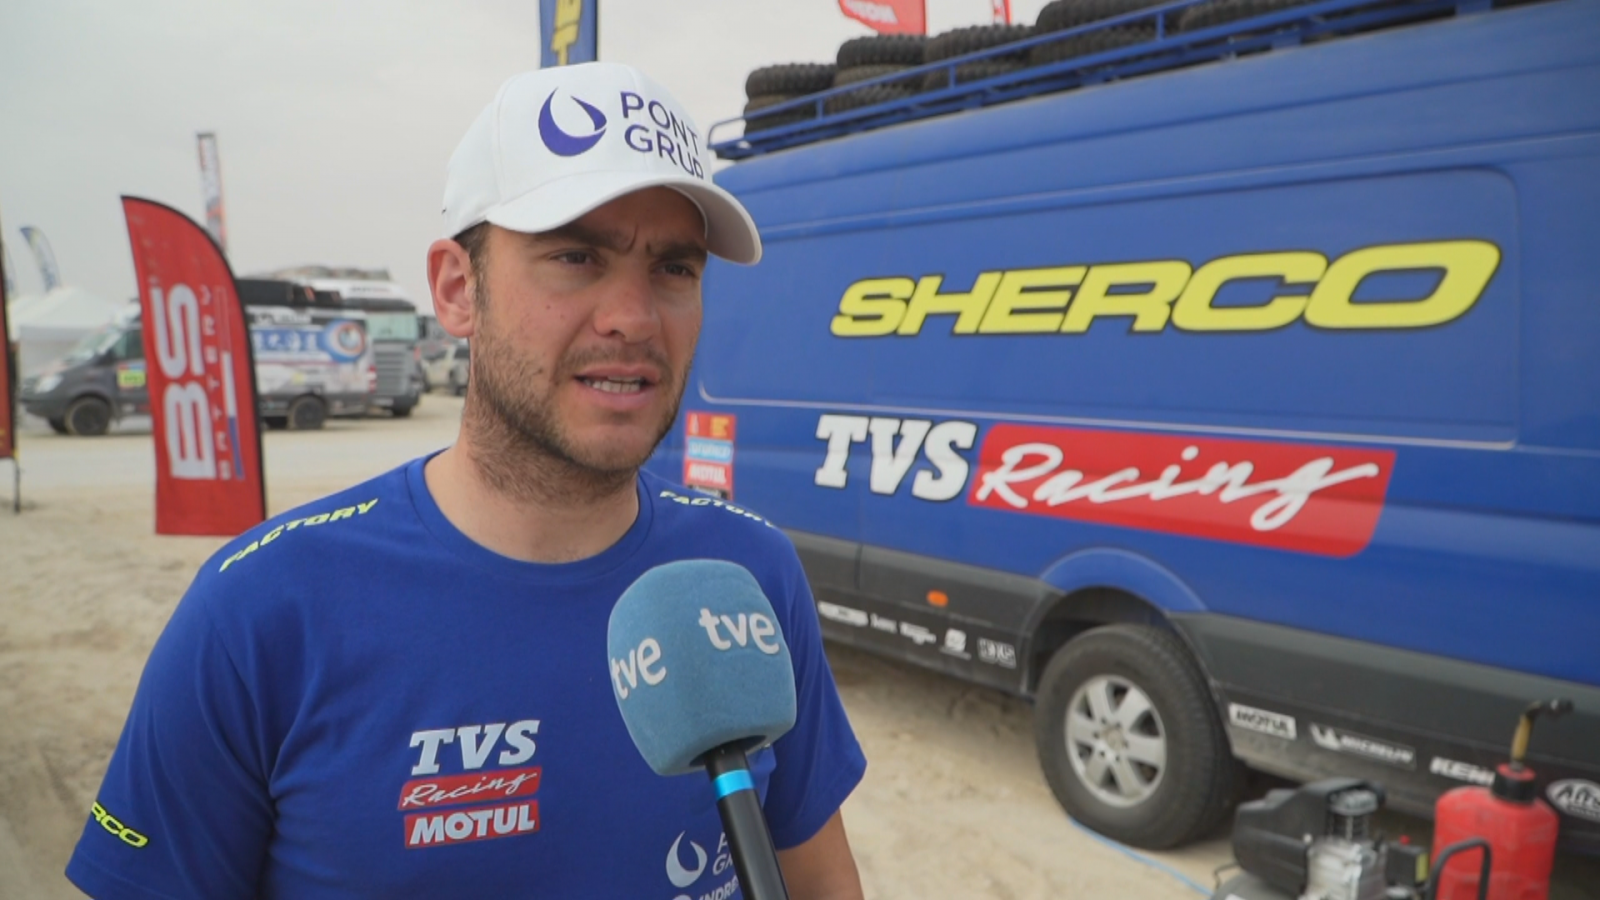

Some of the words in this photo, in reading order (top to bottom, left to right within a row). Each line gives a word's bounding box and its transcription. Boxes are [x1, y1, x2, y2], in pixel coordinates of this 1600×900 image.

[620, 91, 699, 155] PONT
[624, 124, 704, 179] GRUP
[830, 240, 1501, 337] SHERCO
[150, 282, 217, 480] BS
[814, 413, 977, 502] TVS
[976, 443, 1379, 532] Racing
[218, 498, 379, 573] FACTORY
[698, 607, 780, 656] tve
[610, 637, 667, 700] tve
[409, 719, 541, 776] TVS
[1429, 756, 1496, 787] KEN
[402, 773, 537, 807] Racing
[409, 804, 536, 845] MOTUL
